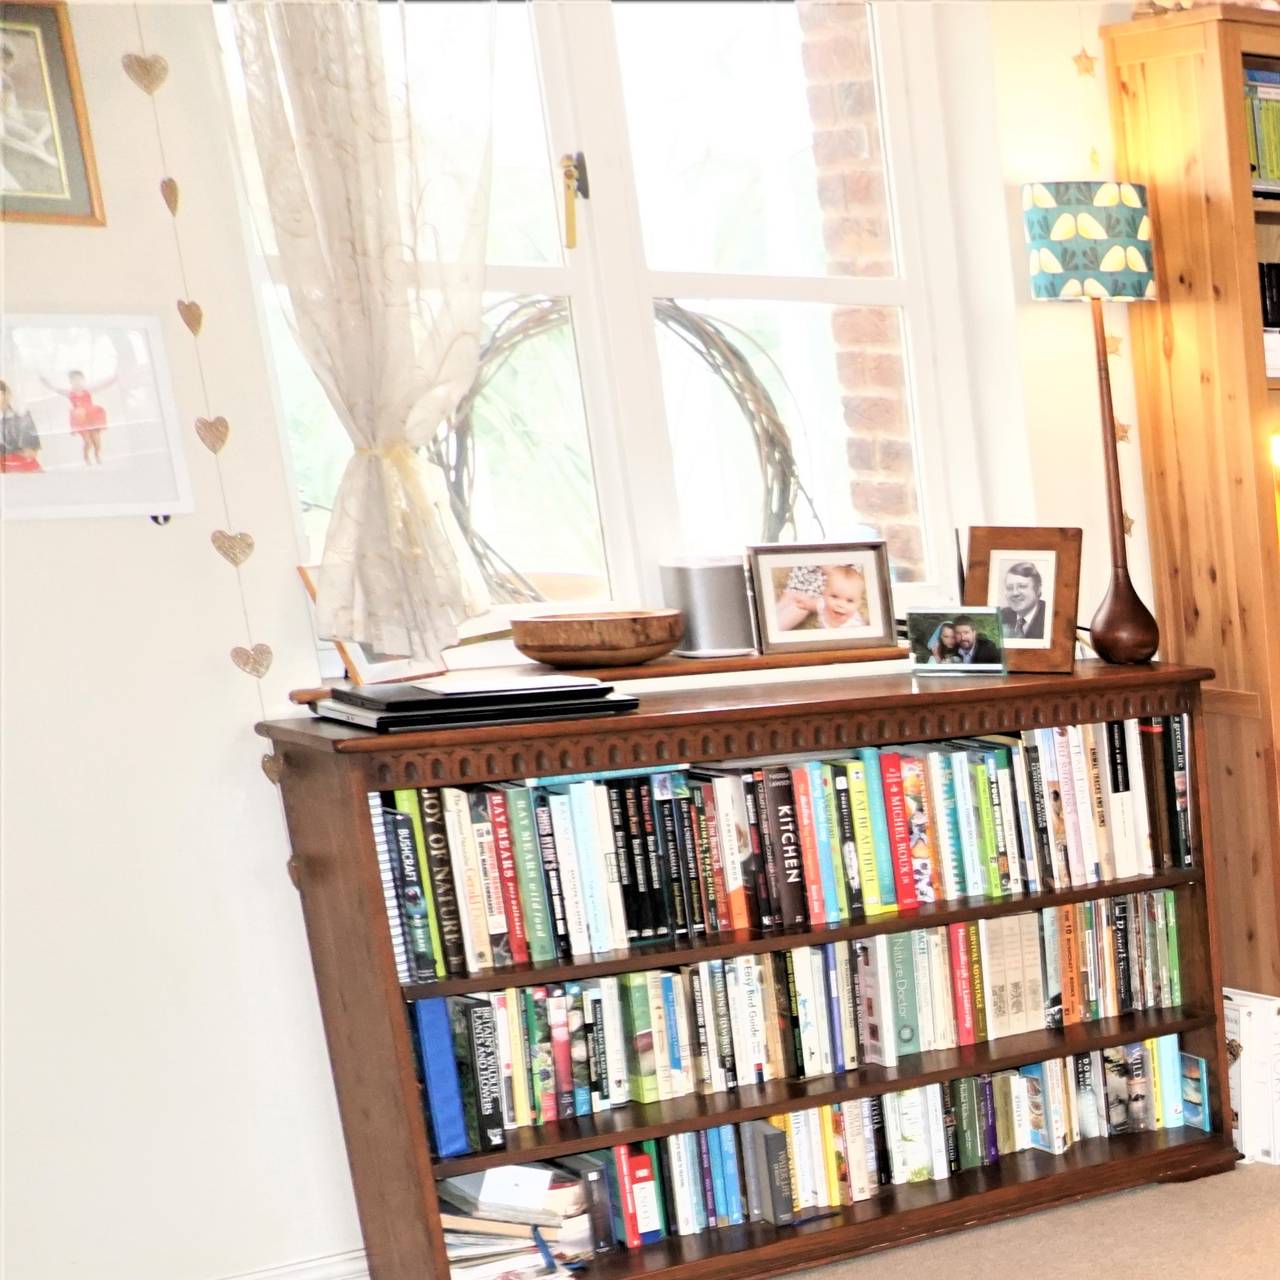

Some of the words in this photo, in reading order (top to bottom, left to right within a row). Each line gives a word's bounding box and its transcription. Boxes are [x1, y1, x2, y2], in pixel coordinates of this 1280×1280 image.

[1173, 723, 1183, 753] greener
[1090, 748, 1098, 769] ANIMAL
[1098, 810, 1106, 827] SIGNS
[422, 789, 442, 825] JOY
[517, 800, 528, 826] RAY
[536, 808, 550, 834] CHRIS
[891, 797, 904, 841] MICHEL
[429, 834, 448, 858] OF
[492, 796, 504, 824] RAY
[498, 828, 514, 878] MEARS
[699, 816, 710, 850] ANIMAL
[778, 806, 800, 882] KITCHEN
[398, 829, 417, 881] BUSHCRAFT
[522, 832, 538, 878] MEARS
[897, 844, 908, 873] ROUX
[702, 853, 715, 901] TRACKING
[433, 867, 460, 946] NATURE
[894, 939, 904, 976] Nature
[970, 927, 979, 961] SURVIVAL
[744, 967, 752, 986] Easy
[972, 965, 982, 1009] ADVANTAGE
[747, 990, 757, 1008] Bird
[896, 979, 907, 1017] Doctor
[473, 1009, 486, 1043] PLANTS
[750, 1011, 759, 1037] Guide
[477, 1047, 488, 1068] AND
[1132, 1048, 1141, 1078] WILD
[481, 1071, 493, 1114] FLOWERS
